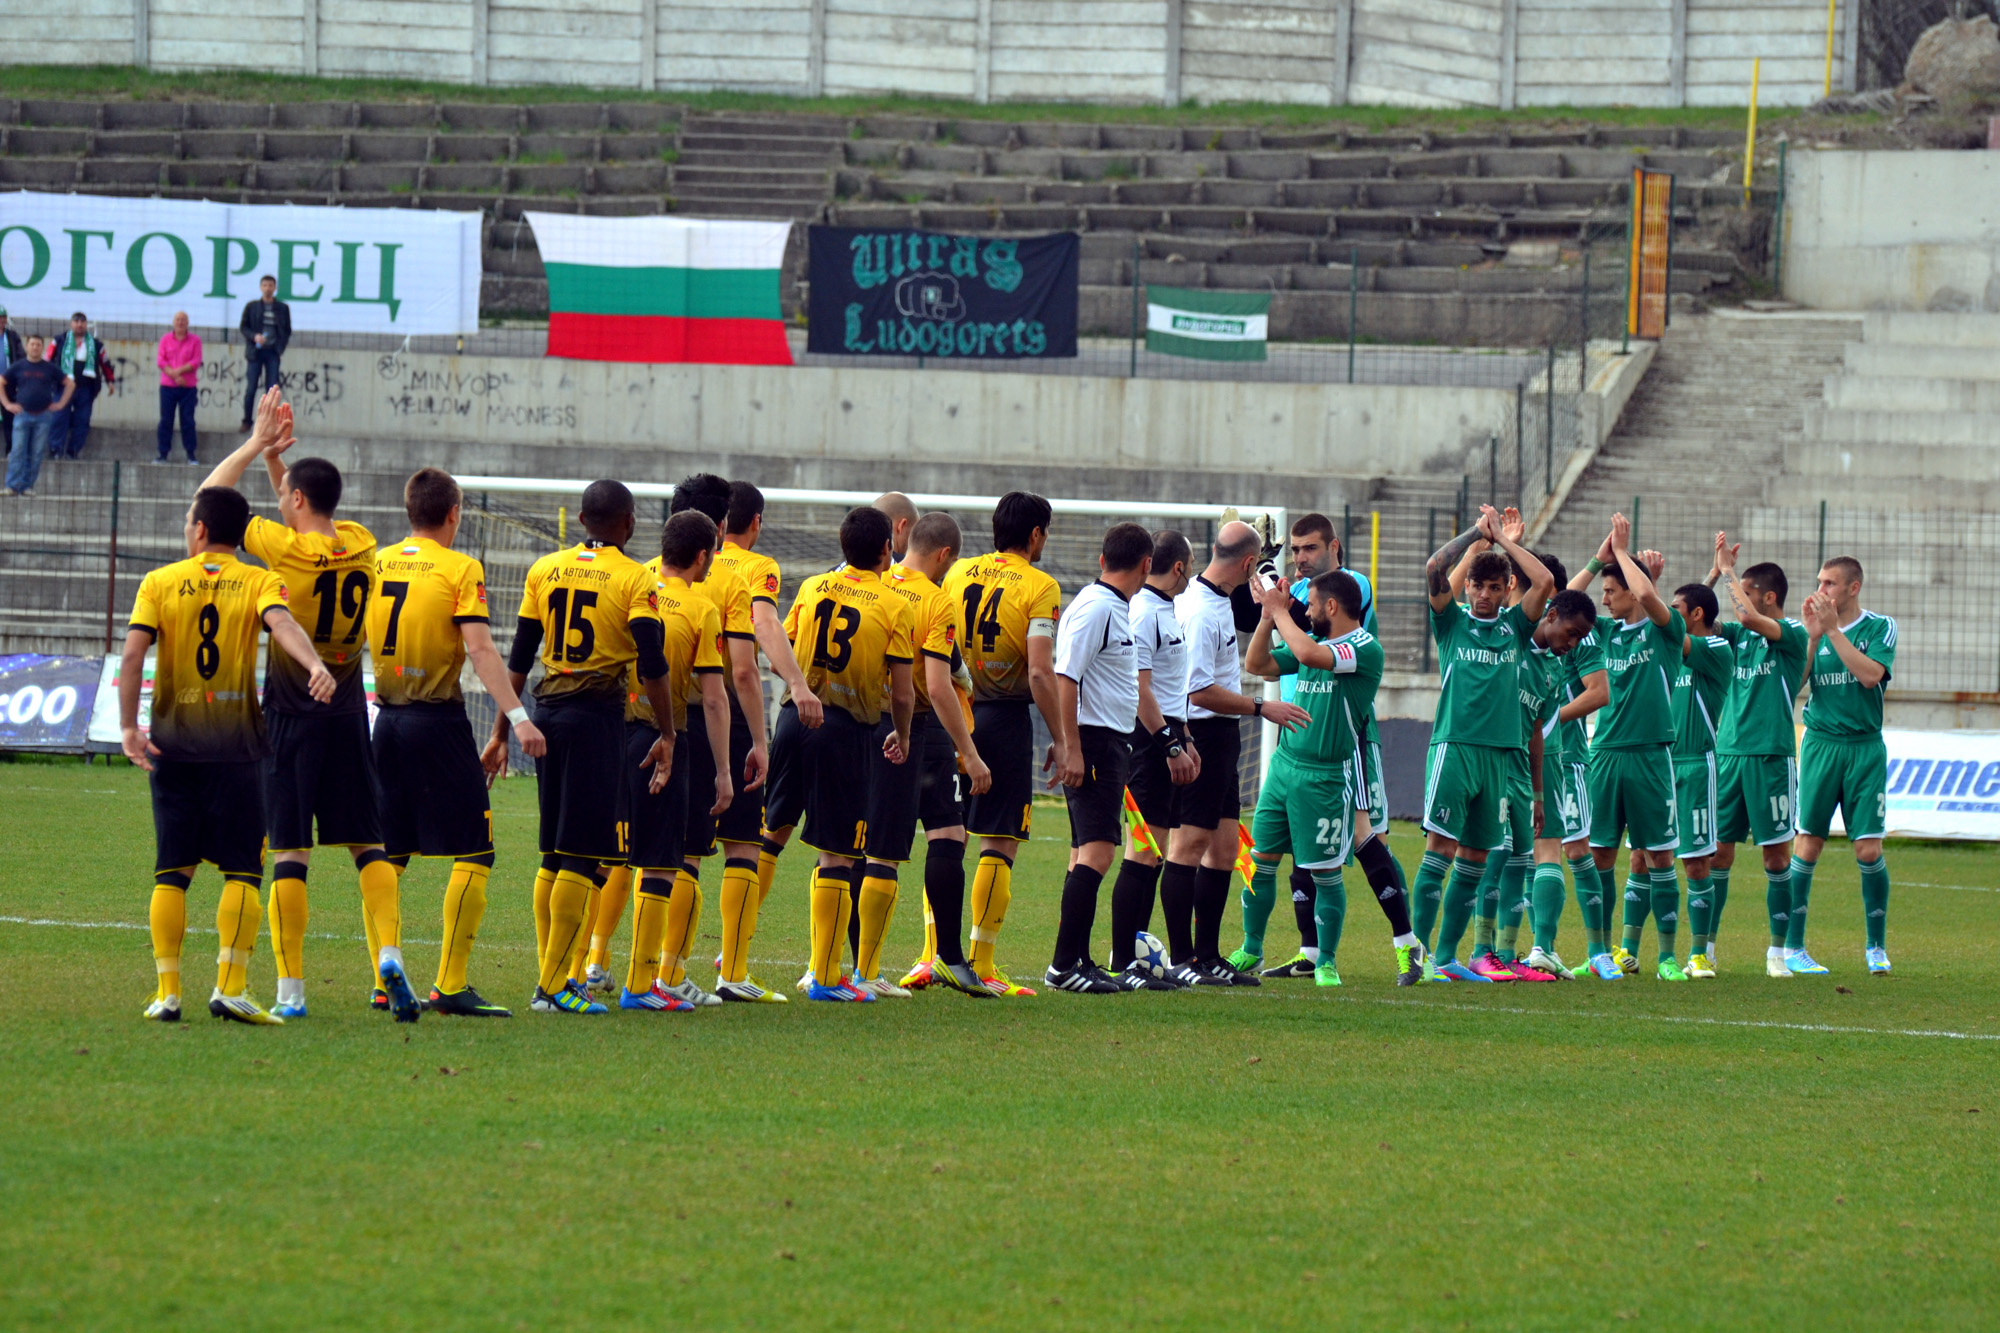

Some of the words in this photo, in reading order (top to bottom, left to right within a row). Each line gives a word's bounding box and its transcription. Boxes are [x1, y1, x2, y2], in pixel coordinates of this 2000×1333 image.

[0, 225, 403, 322] ОГОРЕЦ
[844, 302, 1047, 356] Ludogorets
[386, 560, 435, 573] АВТОМОТОР
[563, 567, 612, 583] АВТОМОТОР
[831, 582, 879, 602] АВТОМОТОР
[312, 569, 370, 645] 19
[380, 580, 409, 656] 7
[548, 587, 599, 663] 15
[963, 582, 1005, 653] 14
[196, 603, 220, 681] 8
[812, 597, 861, 674] 13
[1315, 817, 1343, 845] 22
[1665, 799, 1675, 825] 7
[1692, 808, 1708, 835] 11
[1770, 794, 1789, 822] 19
